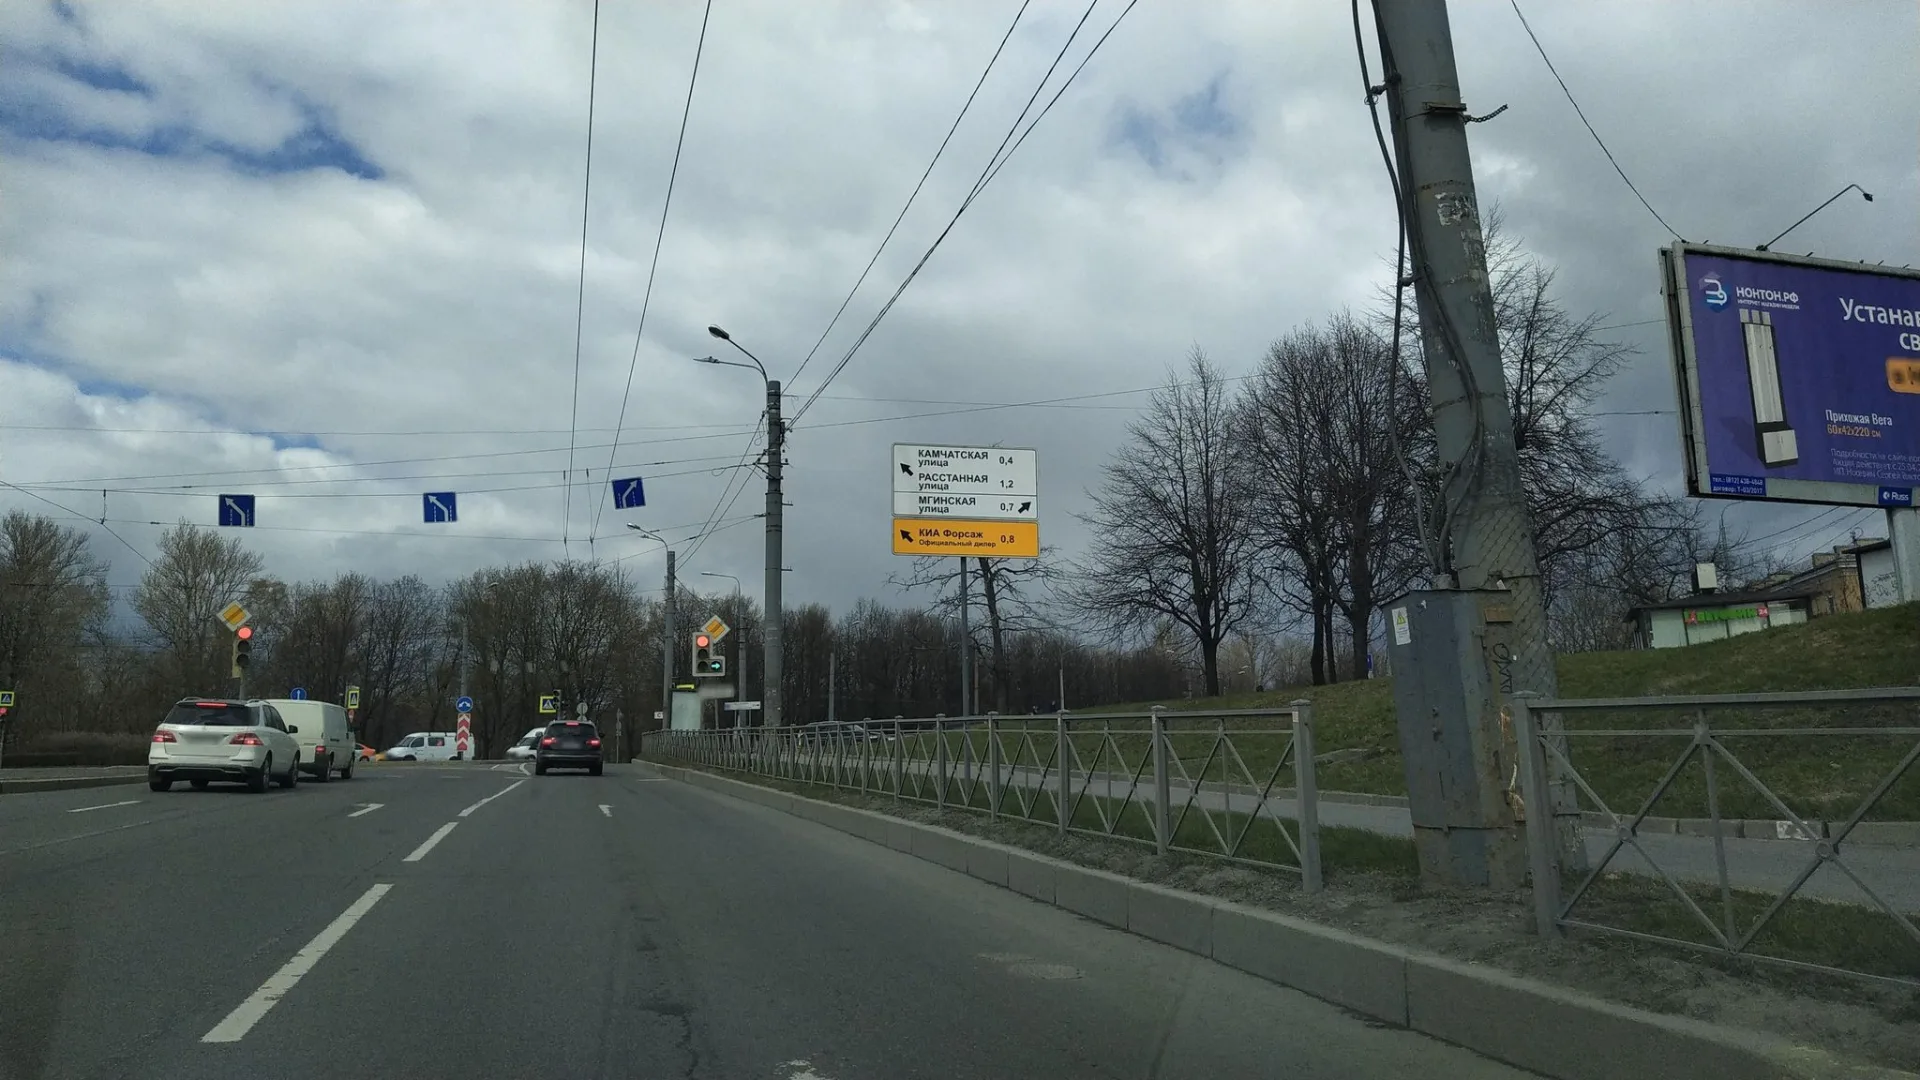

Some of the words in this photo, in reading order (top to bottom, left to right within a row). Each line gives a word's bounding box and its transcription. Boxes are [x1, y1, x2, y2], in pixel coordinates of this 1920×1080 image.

[1736, 286, 1799, 303] НОНТОН.РФ
[1825, 409, 1870, 424] Прихожая
[1871, 413, 1893, 426] Вега
[1871, 430, 1881, 438] см
[918, 449, 988, 460] КАМЧАТСКАЯ
[918, 460, 949, 468] улица
[999, 456, 1013, 466] 0,4
[918, 473, 988, 483] РАССТАННАЯ
[918, 482, 949, 491] улица
[999, 480, 1014, 490] 1,2
[918, 496, 976, 506] МГИНСКАЯ
[1891, 492, 1908, 501] Russ
[918, 505, 949, 514] улица
[1000, 503, 1014, 512] 0,7
[919, 528, 940, 537] КИА
[943, 529, 983, 541] Форсаж
[1000, 535, 1015, 544] 0,8
[919, 539, 972, 548] Официальный
